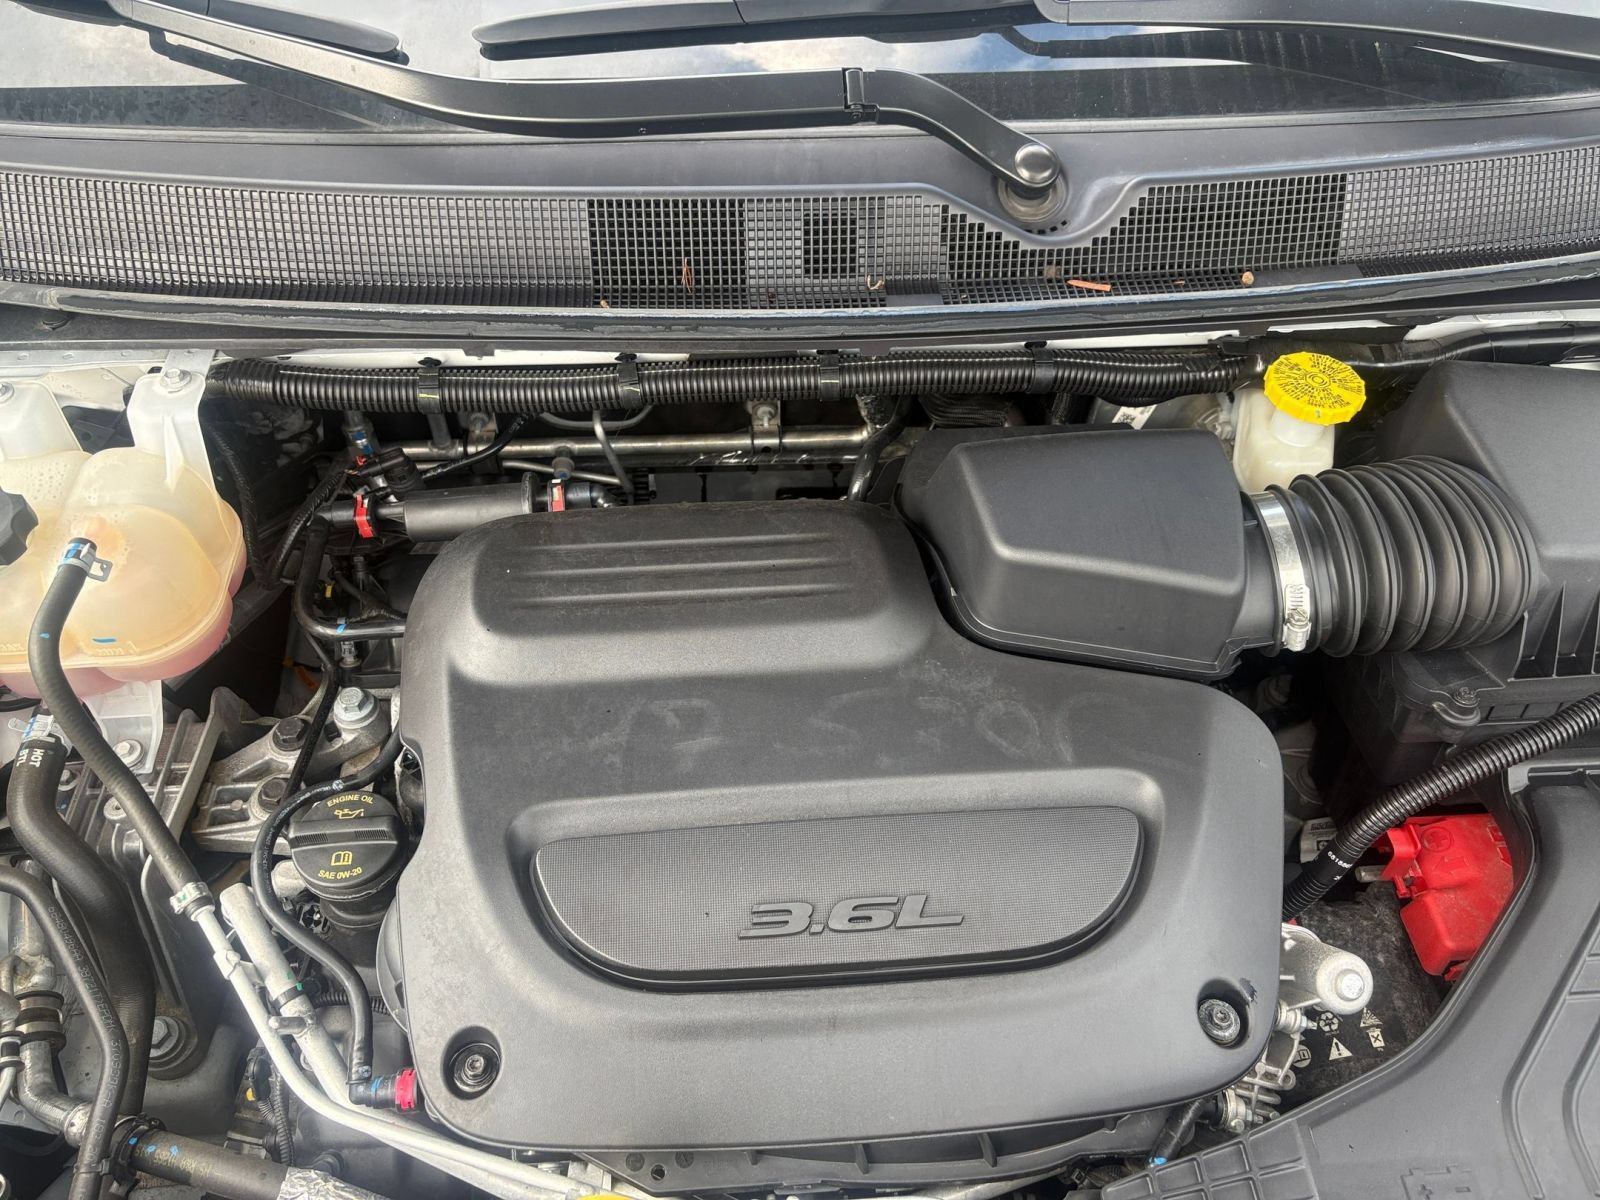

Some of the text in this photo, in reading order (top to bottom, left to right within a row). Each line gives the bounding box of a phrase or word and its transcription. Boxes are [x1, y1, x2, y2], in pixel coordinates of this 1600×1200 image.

[29, 748, 45, 768] HOT
[326, 794, 374, 808] ENGINE OIL
[318, 866, 363, 880] SAE 0W-20
[738, 894, 965, 940] 3.6L
